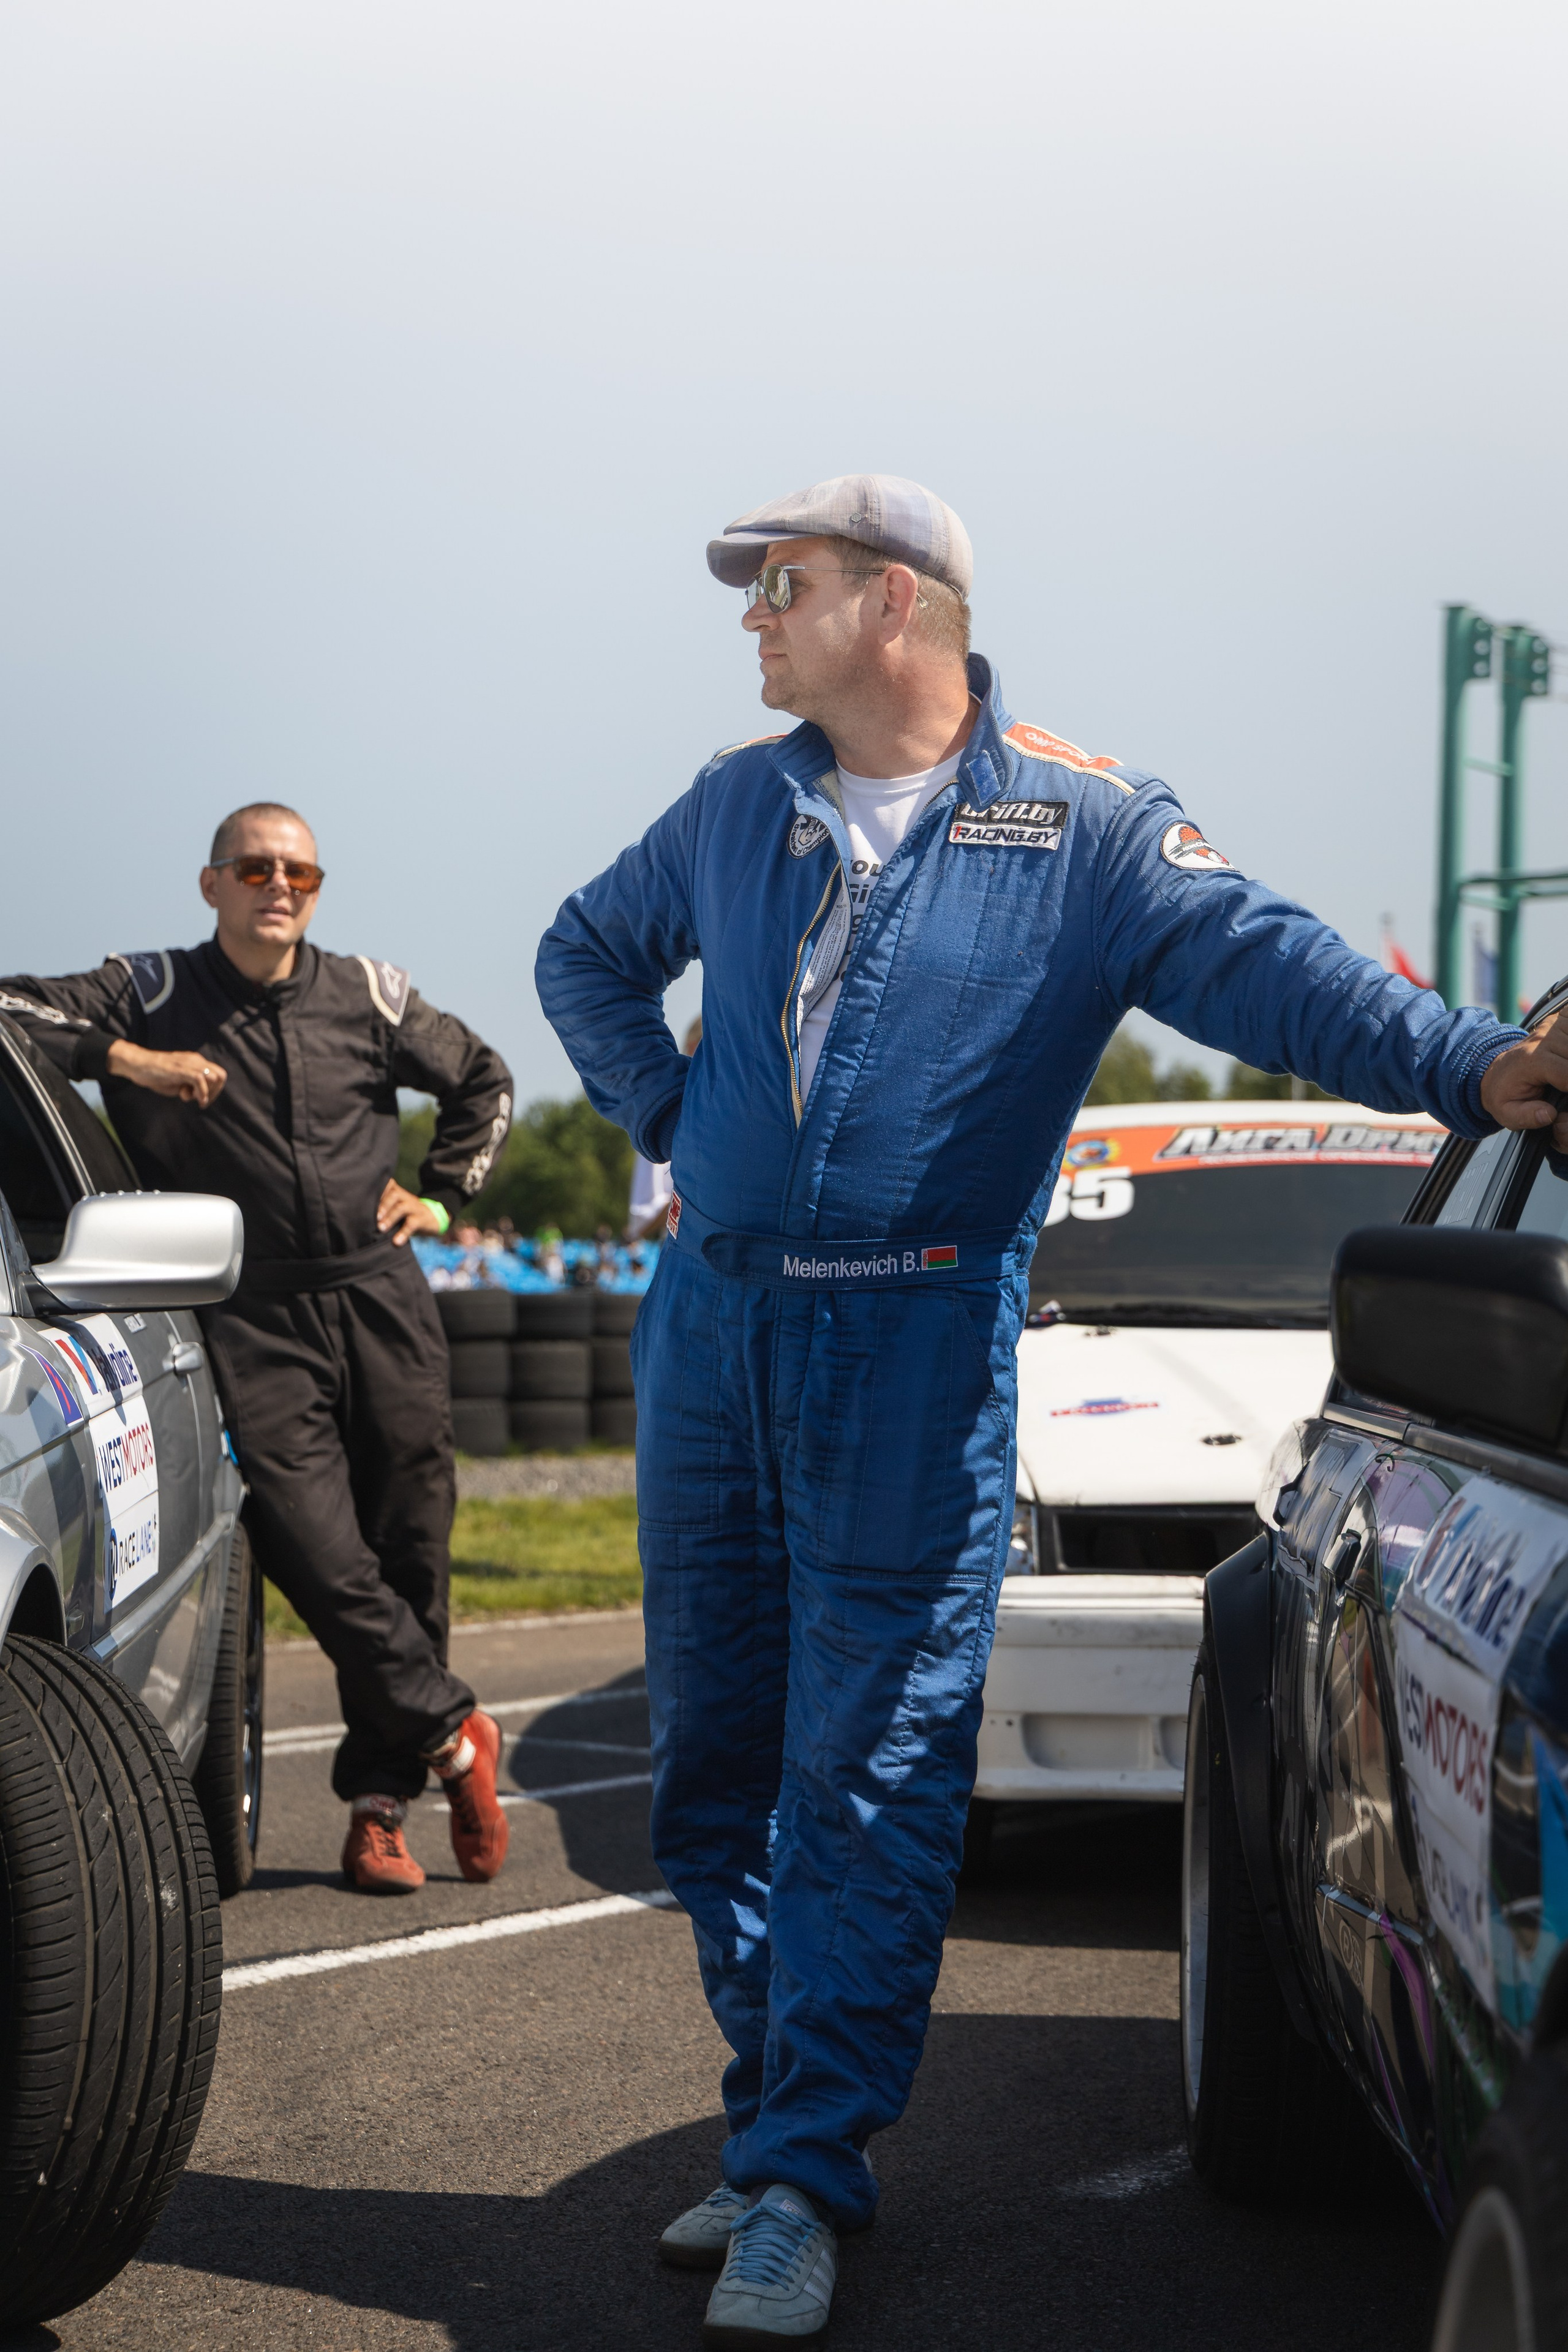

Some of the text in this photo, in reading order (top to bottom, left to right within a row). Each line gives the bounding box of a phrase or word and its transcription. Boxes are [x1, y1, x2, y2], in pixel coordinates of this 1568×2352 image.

[1025, 732, 1055, 747] OMP
[850, 859, 887, 876] ou
[783, 1251, 920, 1278] Melenkevich B.
